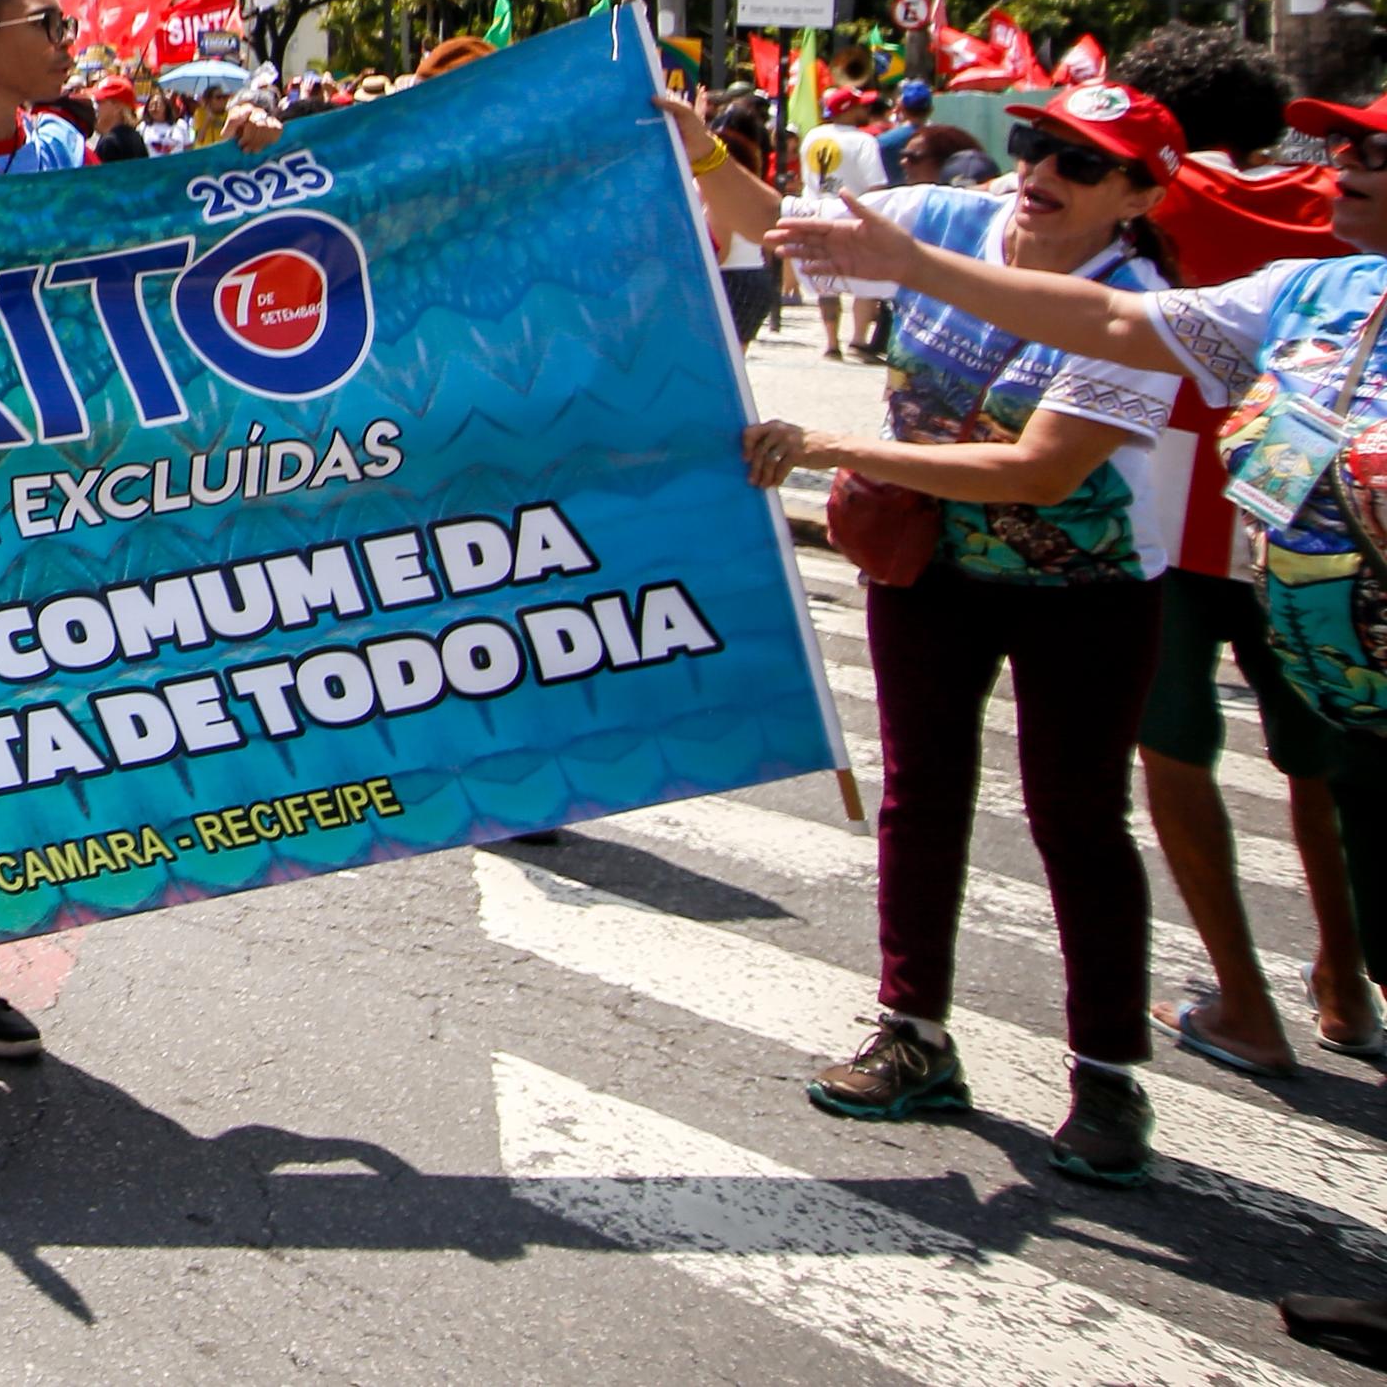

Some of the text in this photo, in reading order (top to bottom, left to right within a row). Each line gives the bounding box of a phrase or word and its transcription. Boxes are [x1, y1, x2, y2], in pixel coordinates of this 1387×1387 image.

[167, 8, 231, 46] SINT
[186, 149, 333, 223] 2025
[220, 271, 257, 327] 7
[257, 292, 275, 307] DE
[13, 419, 404, 539] EXCLUÍDAS
[364, 527, 439, 609] E
[435, 504, 597, 594] DA
[97, 676, 240, 766] DE
[233, 623, 520, 738] TODO
[523, 580, 721, 685] DIA
[202, 777, 404, 851] RECIFE/PE
